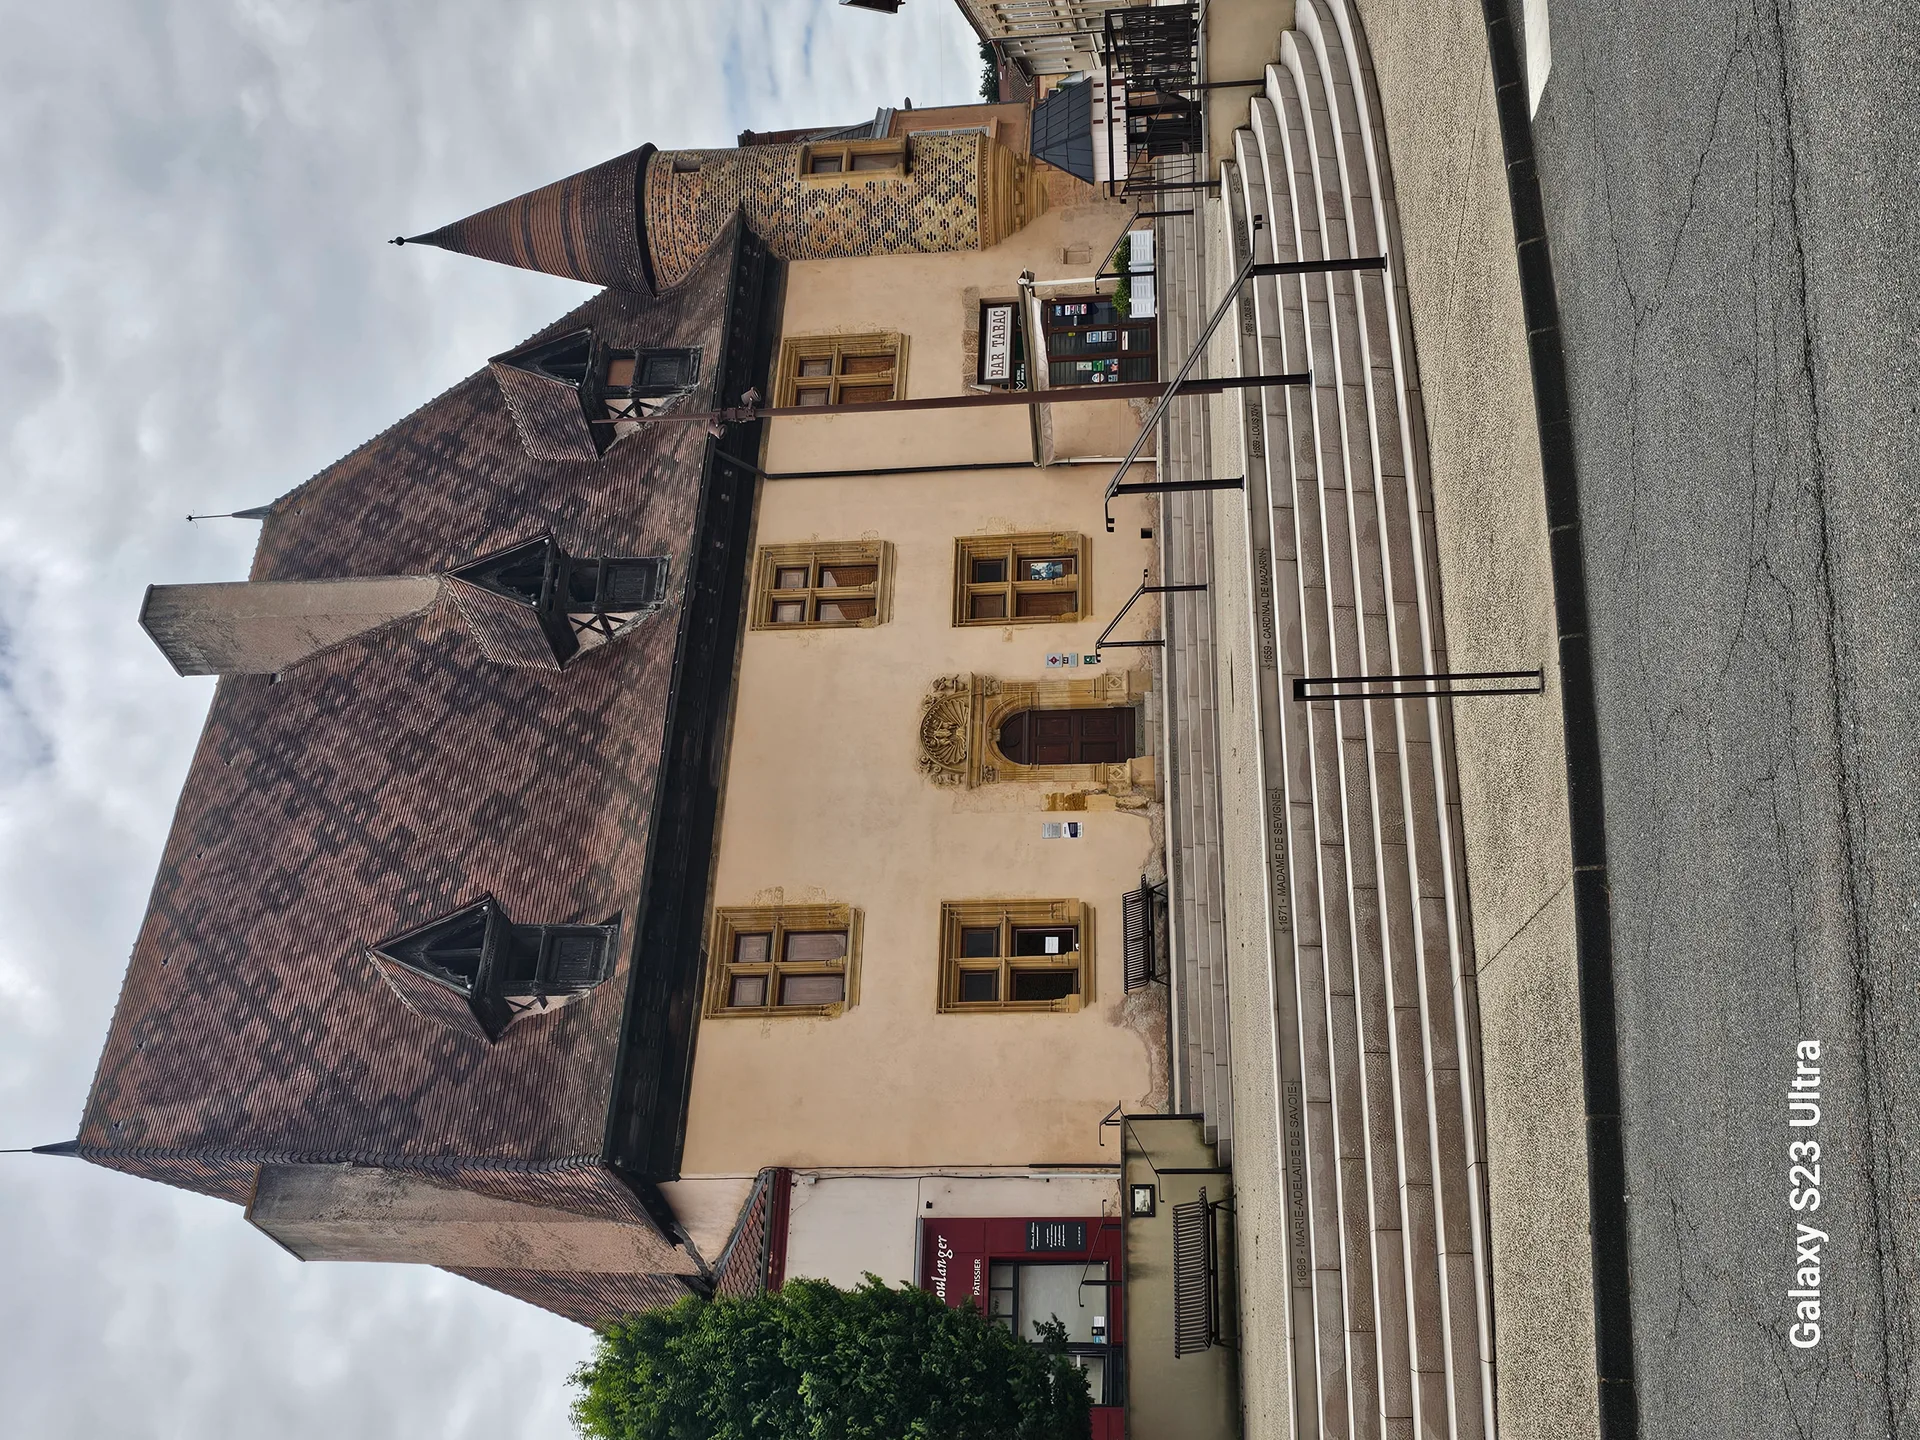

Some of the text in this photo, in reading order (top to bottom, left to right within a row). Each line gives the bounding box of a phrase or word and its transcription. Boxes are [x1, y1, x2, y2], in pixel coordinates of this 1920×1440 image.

[990, 310, 1006, 377] BAR TABAC
[1251, 418, 1260, 435] LOUIS
[1258, 552, 1268, 586] MAZARIN
[1261, 587, 1269, 597] DE
[1261, 600, 1271, 639] CARDINAL
[1264, 646, 1272, 663] 1659
[1272, 793, 1282, 835] SEVIGNE
[1275, 839, 1284, 850] DE
[1275, 854, 1286, 896] MADAME
[1278, 905, 1288, 926] 1671
[1288, 1086, 1299, 1128] SAVOIE
[1290, 1131, 1300, 1146] DE
[1291, 1150, 1306, 1247] MARIE-ADELAIDE
[930, 1234, 954, 1304] oulanger
[972, 1258, 980, 1296] PÂTISSIER
[1296, 1258, 1307, 1282] 1696
